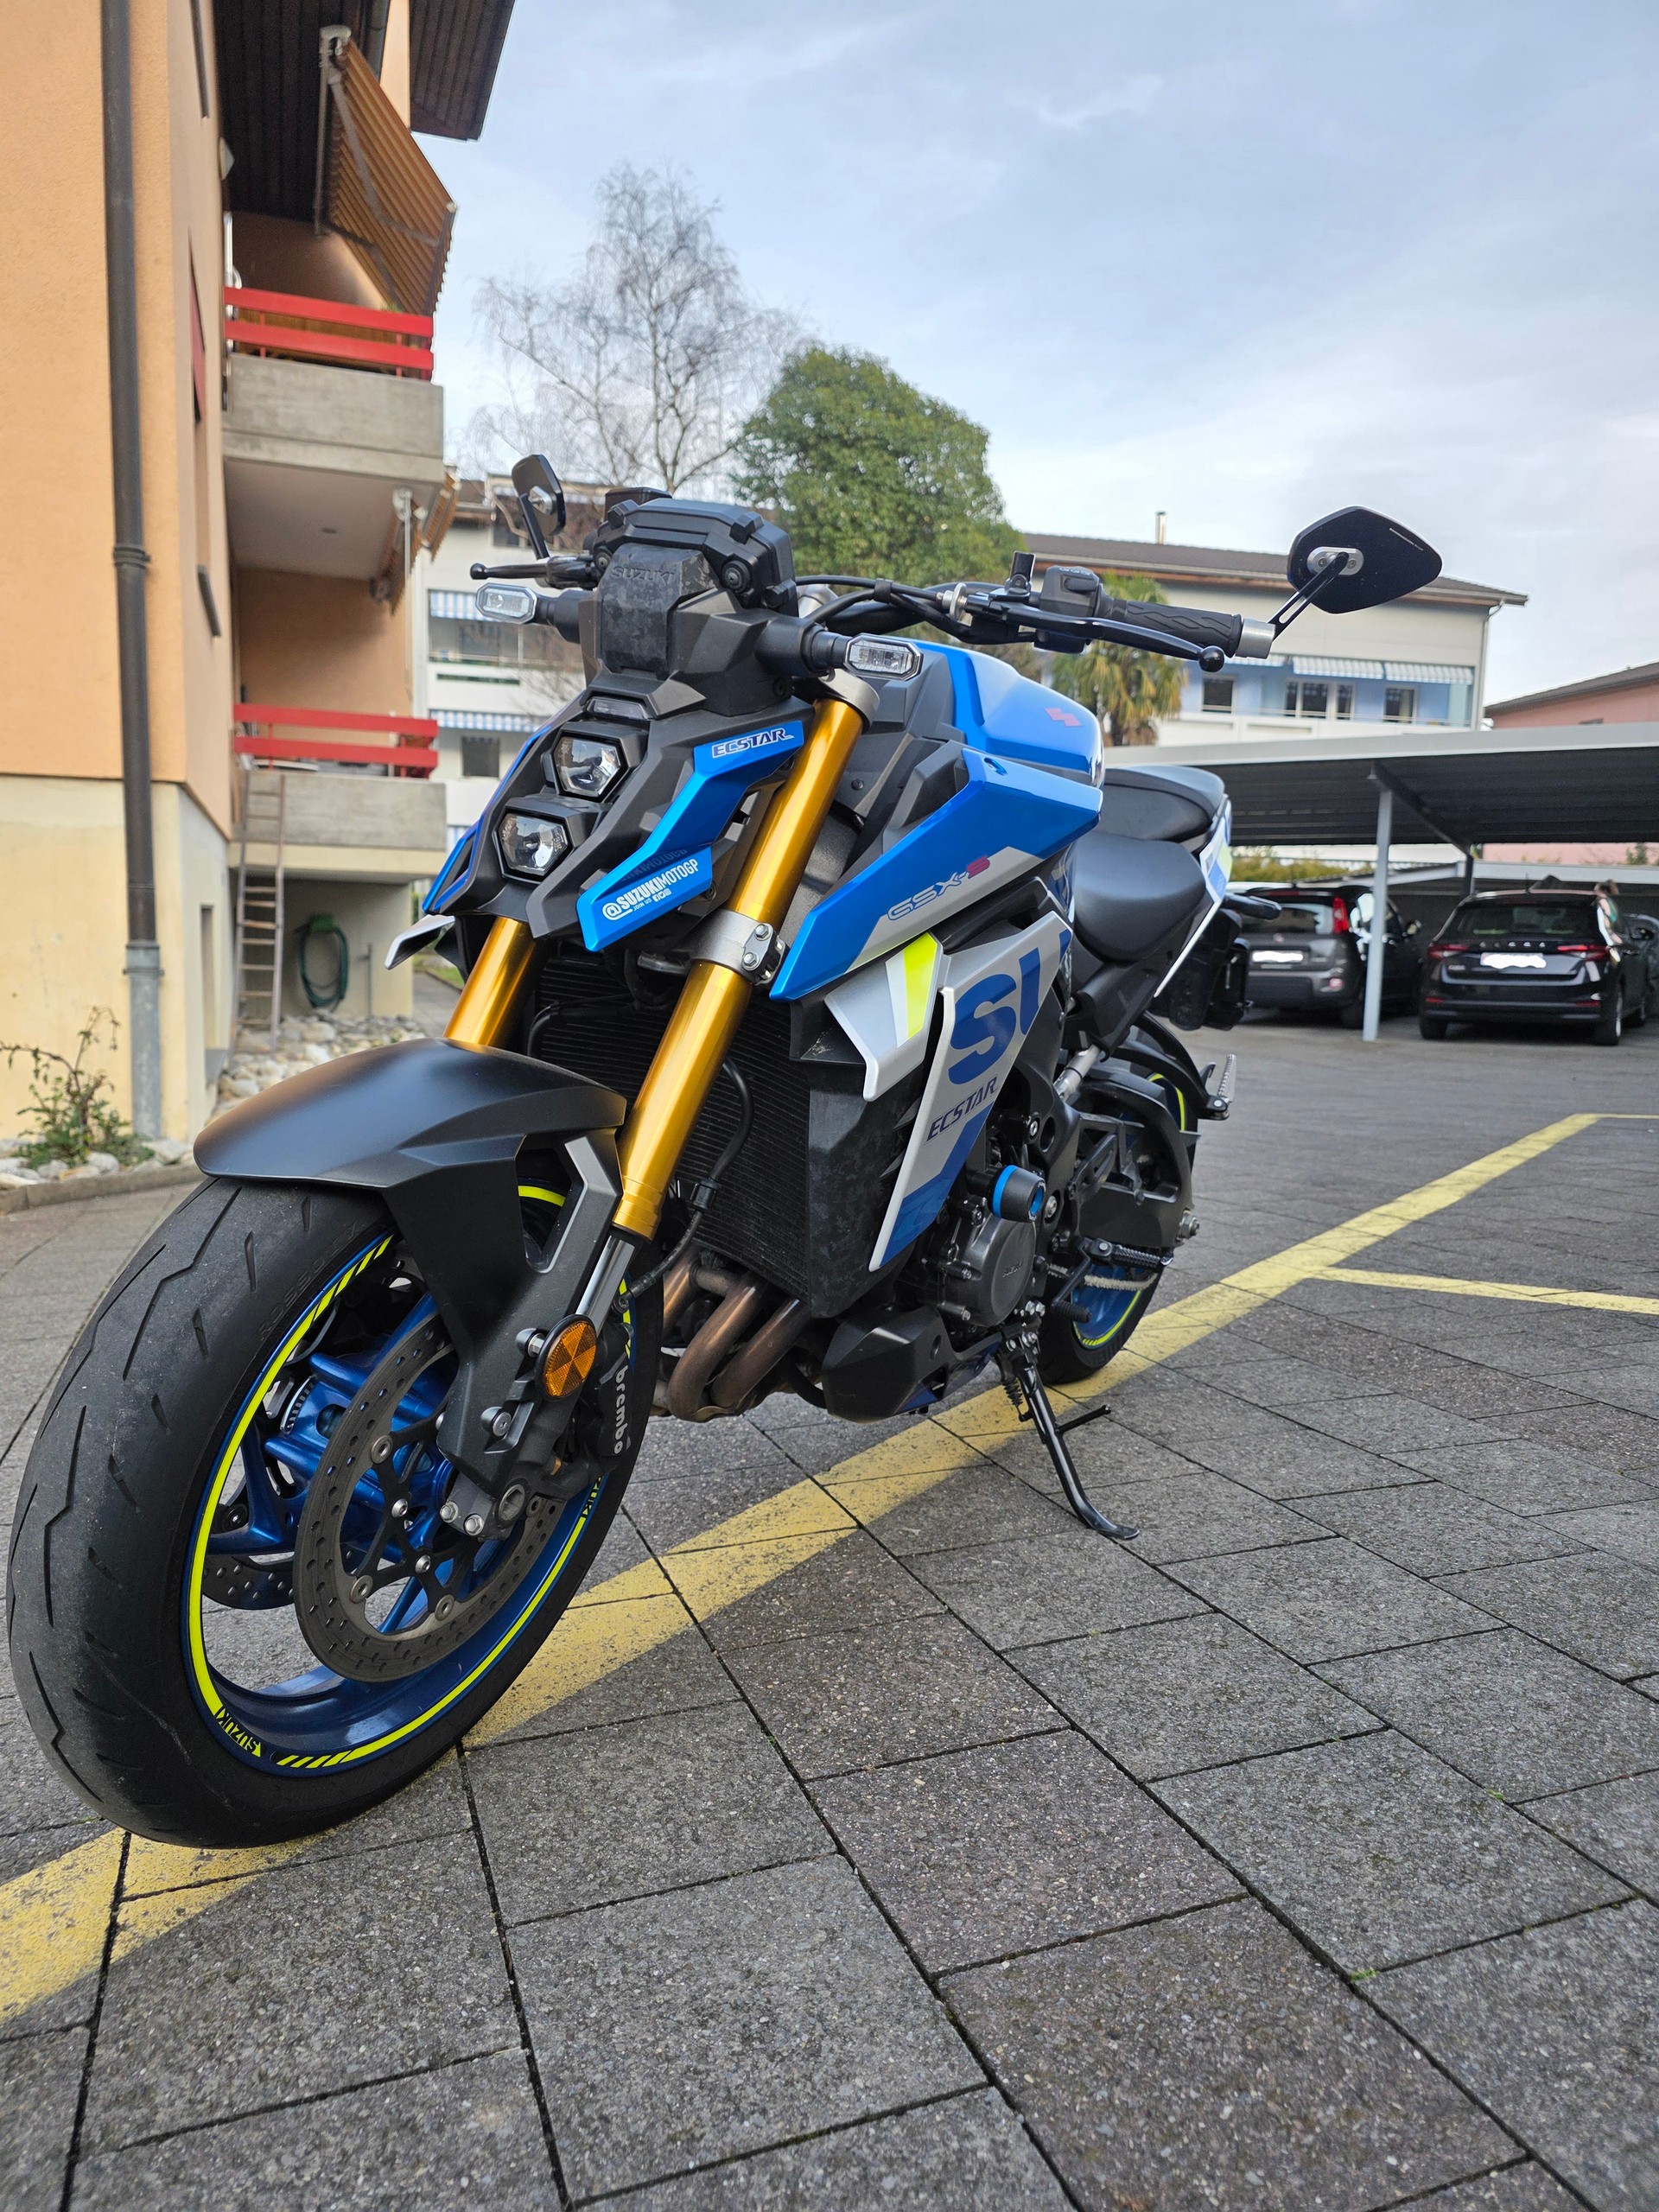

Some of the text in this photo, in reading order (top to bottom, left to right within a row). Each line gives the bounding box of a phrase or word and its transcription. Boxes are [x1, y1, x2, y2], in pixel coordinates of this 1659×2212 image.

[610, 566, 675, 585] SUZUKI
[711, 728, 794, 758] ECSTAR
[602, 858, 698, 921] @SUZUKIMOTOGP
[887, 855, 990, 921] GSX-S
[926, 1077, 999, 1143] ECSTAR
[614, 1364, 629, 1454] brembo
[213, 1706, 259, 1753] SUZUKI
